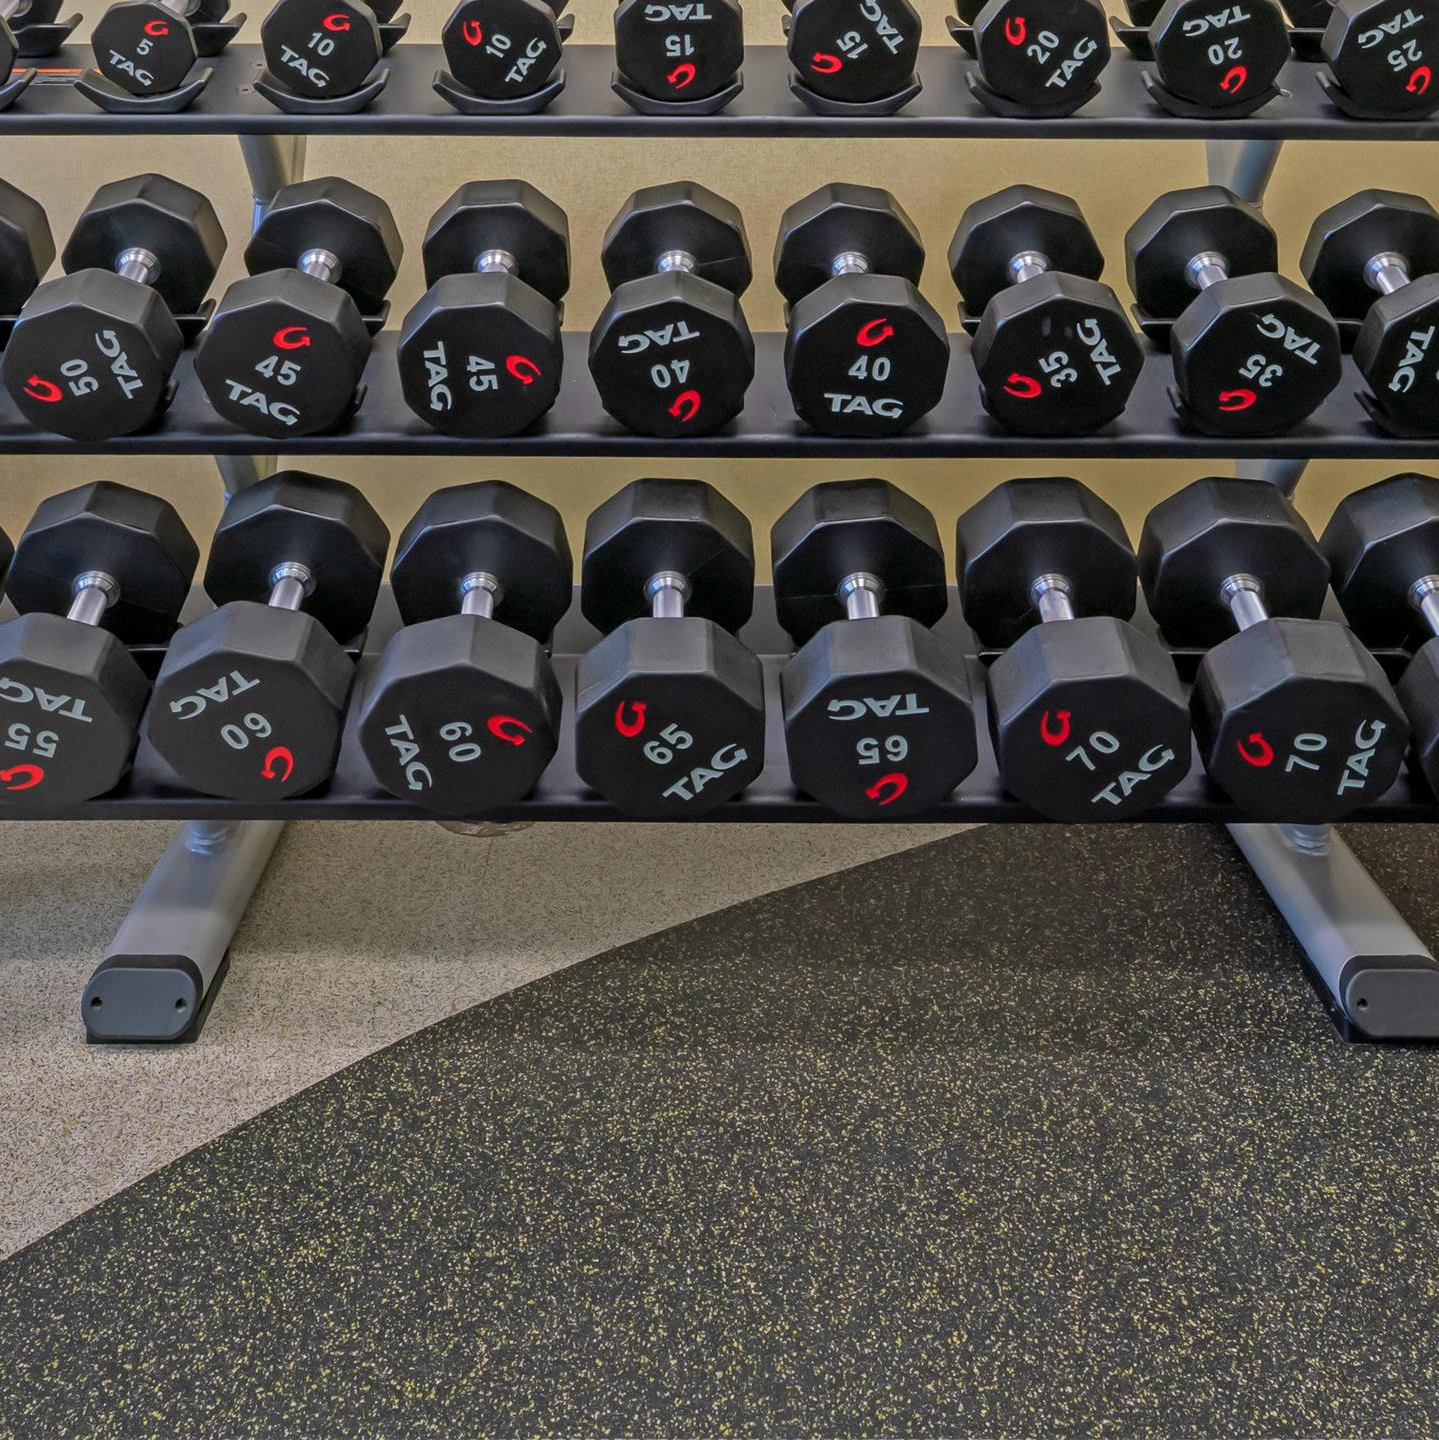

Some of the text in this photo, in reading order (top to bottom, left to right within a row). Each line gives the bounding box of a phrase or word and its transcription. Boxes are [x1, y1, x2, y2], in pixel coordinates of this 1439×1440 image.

[644, 3, 713, 22] TAG
[1182, 5, 1251, 37] TAG
[1357, 8, 1424, 49] TAG
[136, 38, 154, 56] 5
[307, 32, 335, 57] 10
[485, 33, 512, 59] 10
[504, 37, 547, 83] TAG
[665, 34, 695, 57] 15
[836, 30, 869, 59] 15
[1026, 30, 1060, 65] 20
[1207, 36, 1243, 66] 20
[1387, 38, 1423, 72] 25
[109, 49, 154, 86] TAG
[279, 44, 331, 89] TAG
[1044, 36, 1099, 91] TAG
[847, 354, 891, 382] 40
[823, 392, 904, 419] TAG
[169, 670, 261, 720] TAG
[827, 693, 930, 721] TAG
[4, 722, 60, 759] 55
[220, 712, 272, 750] 60
[439, 721, 482, 763] 60
[643, 722, 694, 765] 65
[856, 734, 908, 765] 65
[384, 713, 433, 791] TAG
[1065, 730, 1120, 771] 70
[1284, 733, 1328, 773] 70
[1336, 719, 1387, 796] TAG
[661, 743, 748, 801] TAG
[1090, 743, 1175, 806] TAG
